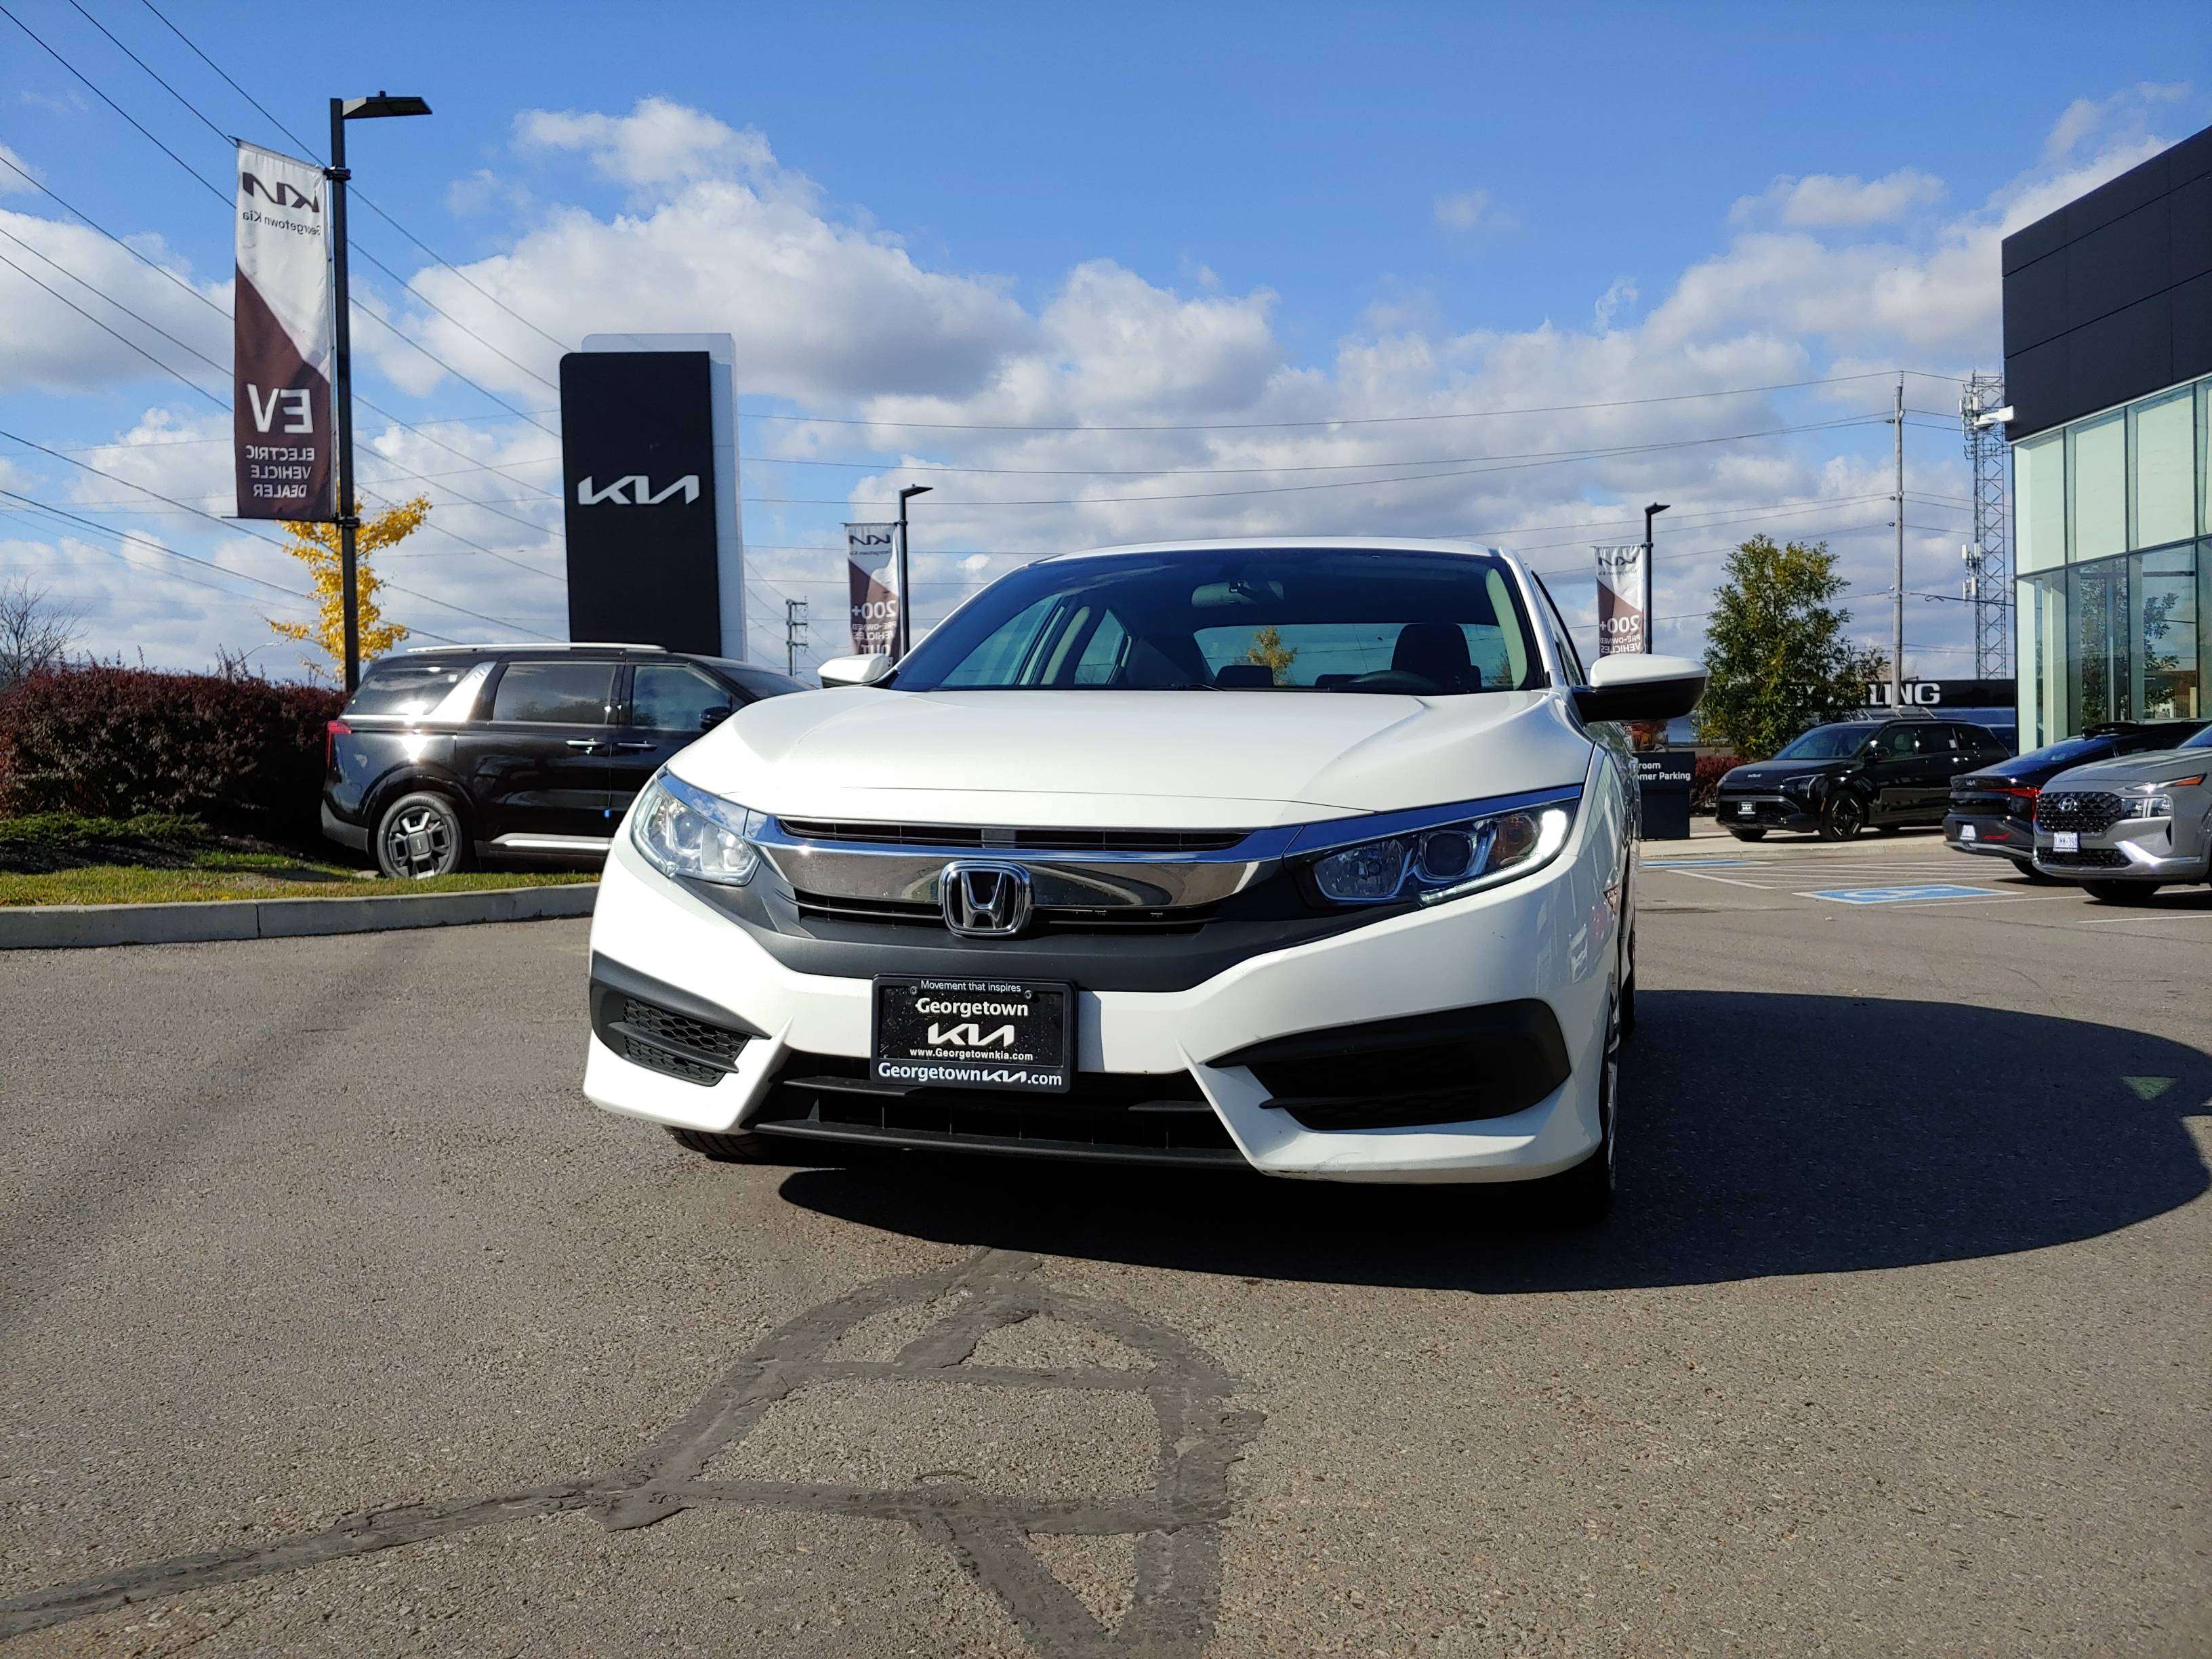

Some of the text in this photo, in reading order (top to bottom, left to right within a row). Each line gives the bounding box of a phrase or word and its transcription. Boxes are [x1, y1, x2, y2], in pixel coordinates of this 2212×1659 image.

[577, 474, 700, 505] KIA
[1659, 771, 1692, 781] Parking
[920, 980, 1021, 993] Movement that inspires
[916, 998, 1029, 1017] Georgetown
[928, 1022, 1015, 1047] KIA
[909, 1048, 1033, 1061] www.Georgetownkia.com
